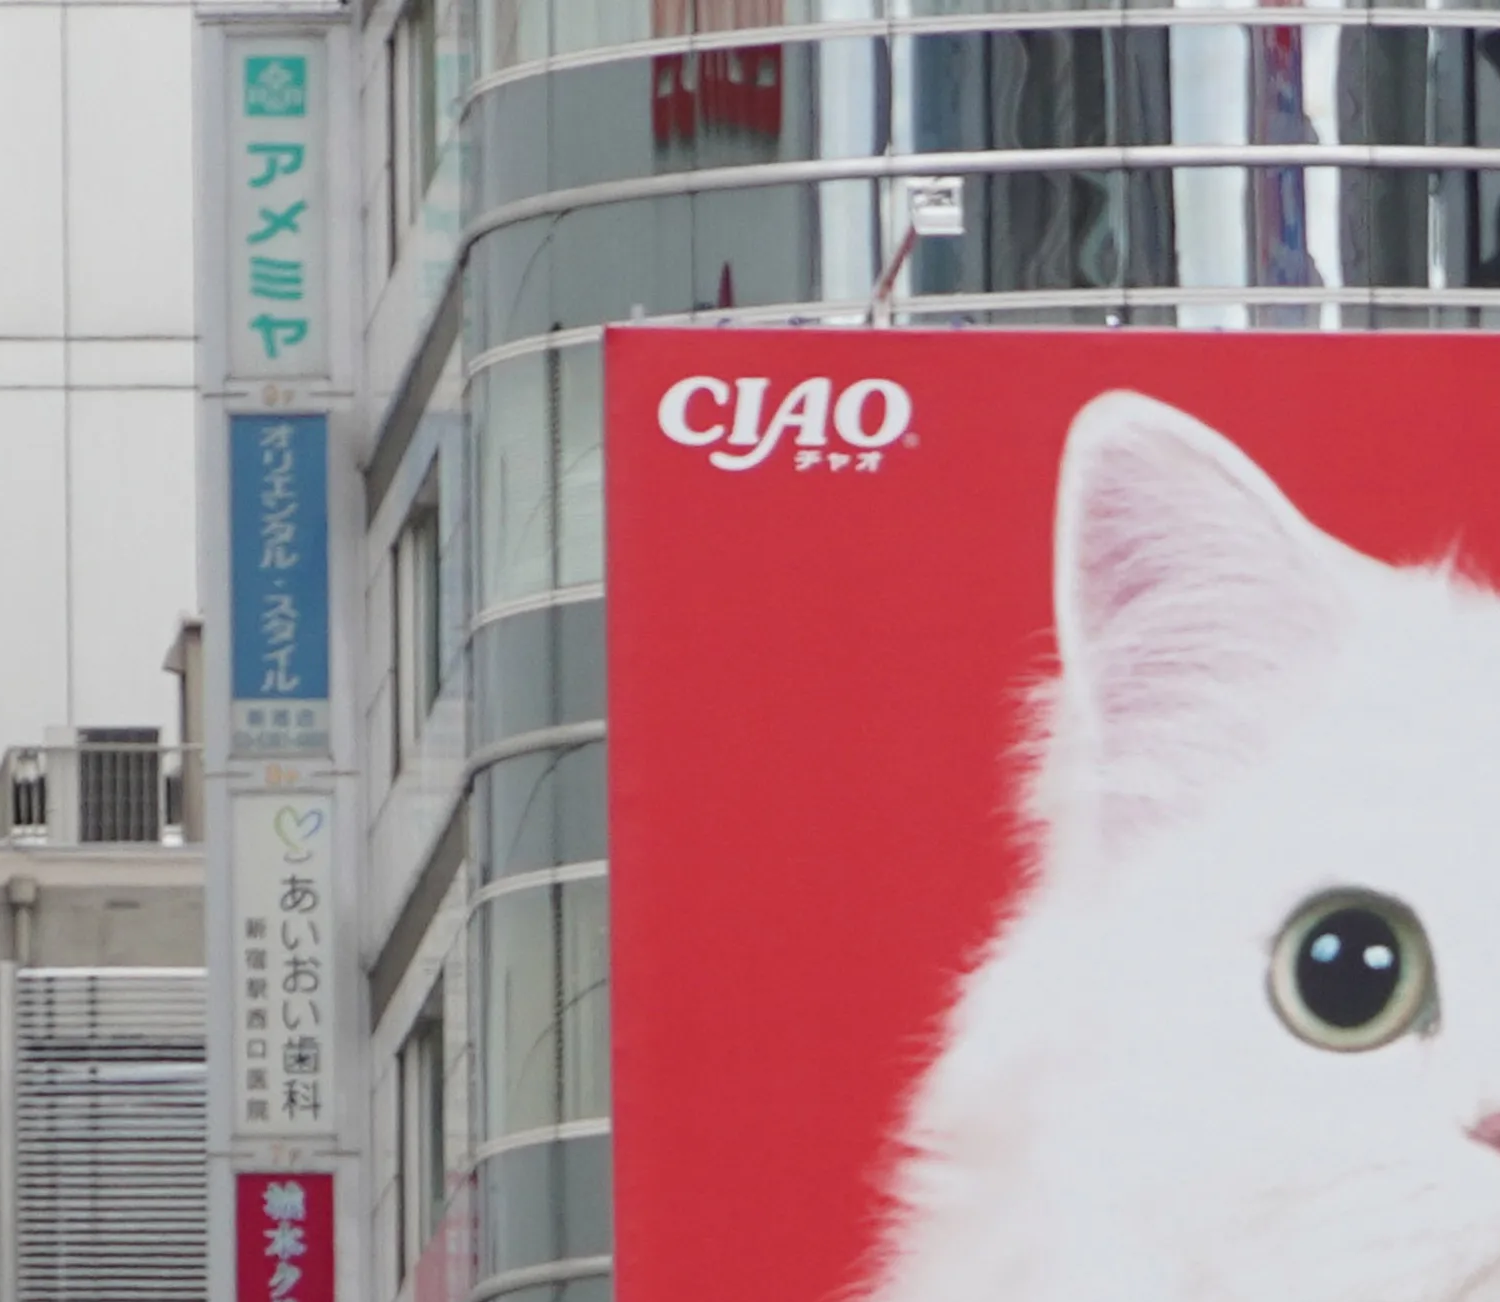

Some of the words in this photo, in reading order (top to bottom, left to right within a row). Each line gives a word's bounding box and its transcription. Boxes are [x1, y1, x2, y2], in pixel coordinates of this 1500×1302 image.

[657, 375, 913, 471] CIAO
[793, 449, 883, 473] チャオ
[279, 873, 321, 1122] あいおい歯科
